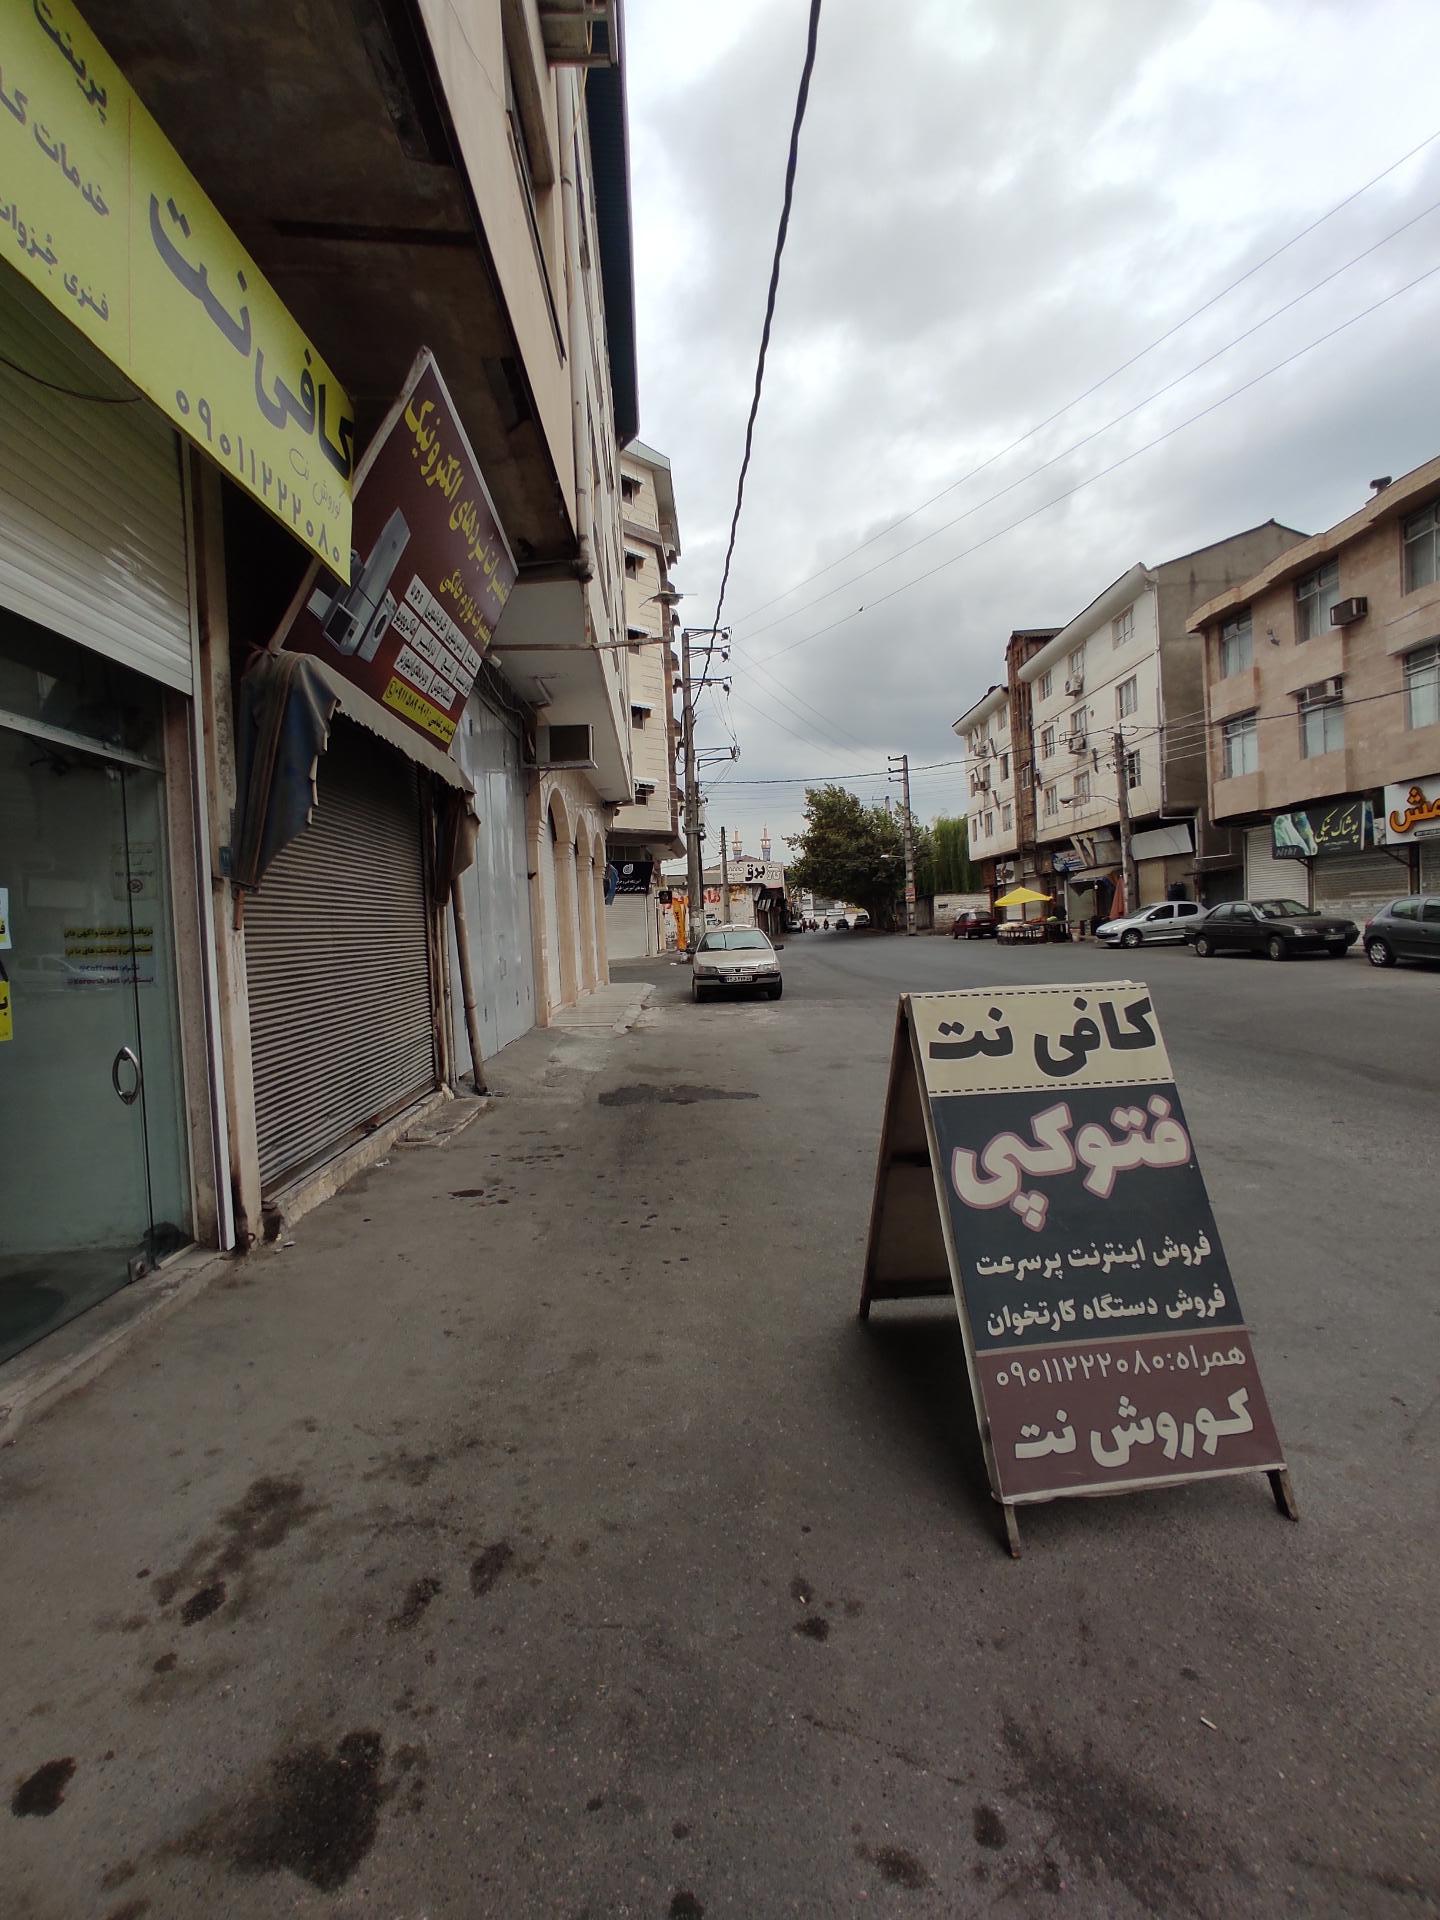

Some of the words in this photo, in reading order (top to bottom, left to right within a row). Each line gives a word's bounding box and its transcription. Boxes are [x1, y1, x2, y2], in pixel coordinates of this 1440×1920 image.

[34, 120, 110, 217] خدمات
[63, 271, 110, 323] فنری
[150, 191, 253, 358] نت
[255, 348, 353, 481] کافی
[404, 396, 464, 503] الکترونیک
[175, 388, 341, 564] ۰۹۰۱۱۲۲۲۰۸۰
[439, 568, 464, 599] خانگی
[1331, 804, 1361, 844] پوشاک
[745, 864, 765, 882] برق
[929, 1006, 1015, 1060] نت
[1034, 996, 1158, 1077] کافی
[951, 1094, 1192, 1233] فتوکپی
[976, 1250, 1063, 1281] پرسرعت
[1069, 1238, 1146, 1269] اینترنت
[1153, 1229, 1212, 1266] فروش
[988, 1299, 1076, 1337] کارتخوان
[1084, 1292, 1159, 1323] دستگاه
[1166, 1283, 1227, 1320] فروش
[1015, 1408, 1078, 1459] نت
[1090, 1387, 1254, 1468] کوروش
